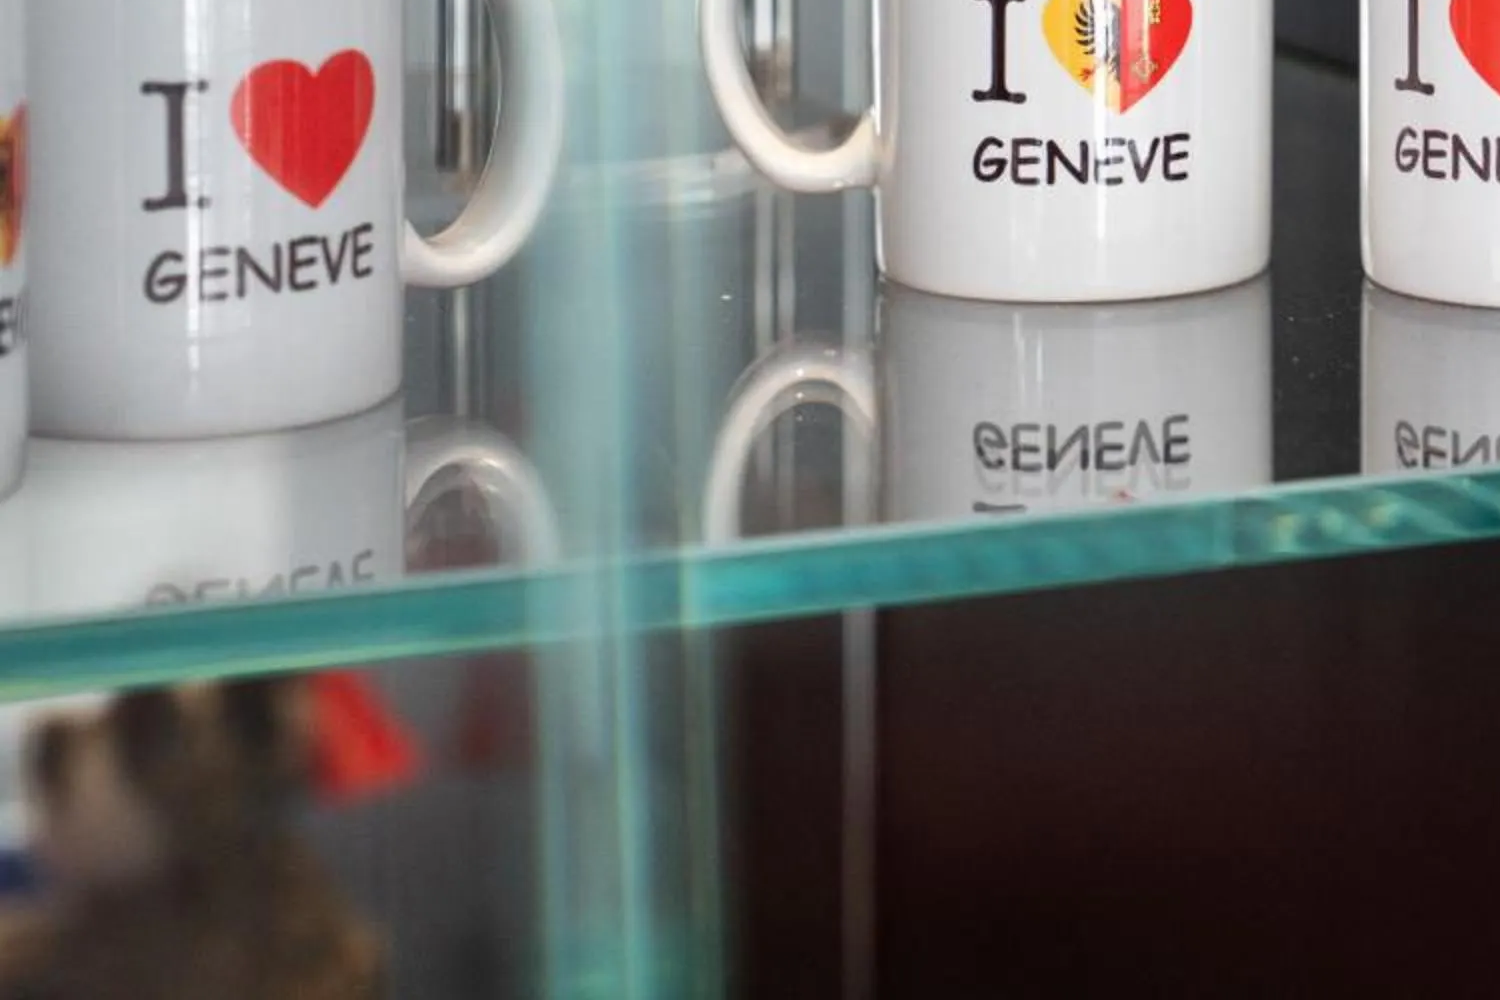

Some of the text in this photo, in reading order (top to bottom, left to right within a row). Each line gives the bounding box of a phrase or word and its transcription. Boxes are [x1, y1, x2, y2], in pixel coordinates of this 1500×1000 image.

[139, 80, 210, 213] I
[972, 132, 1192, 186] GENEVE
[142, 221, 375, 305] GENEVE
